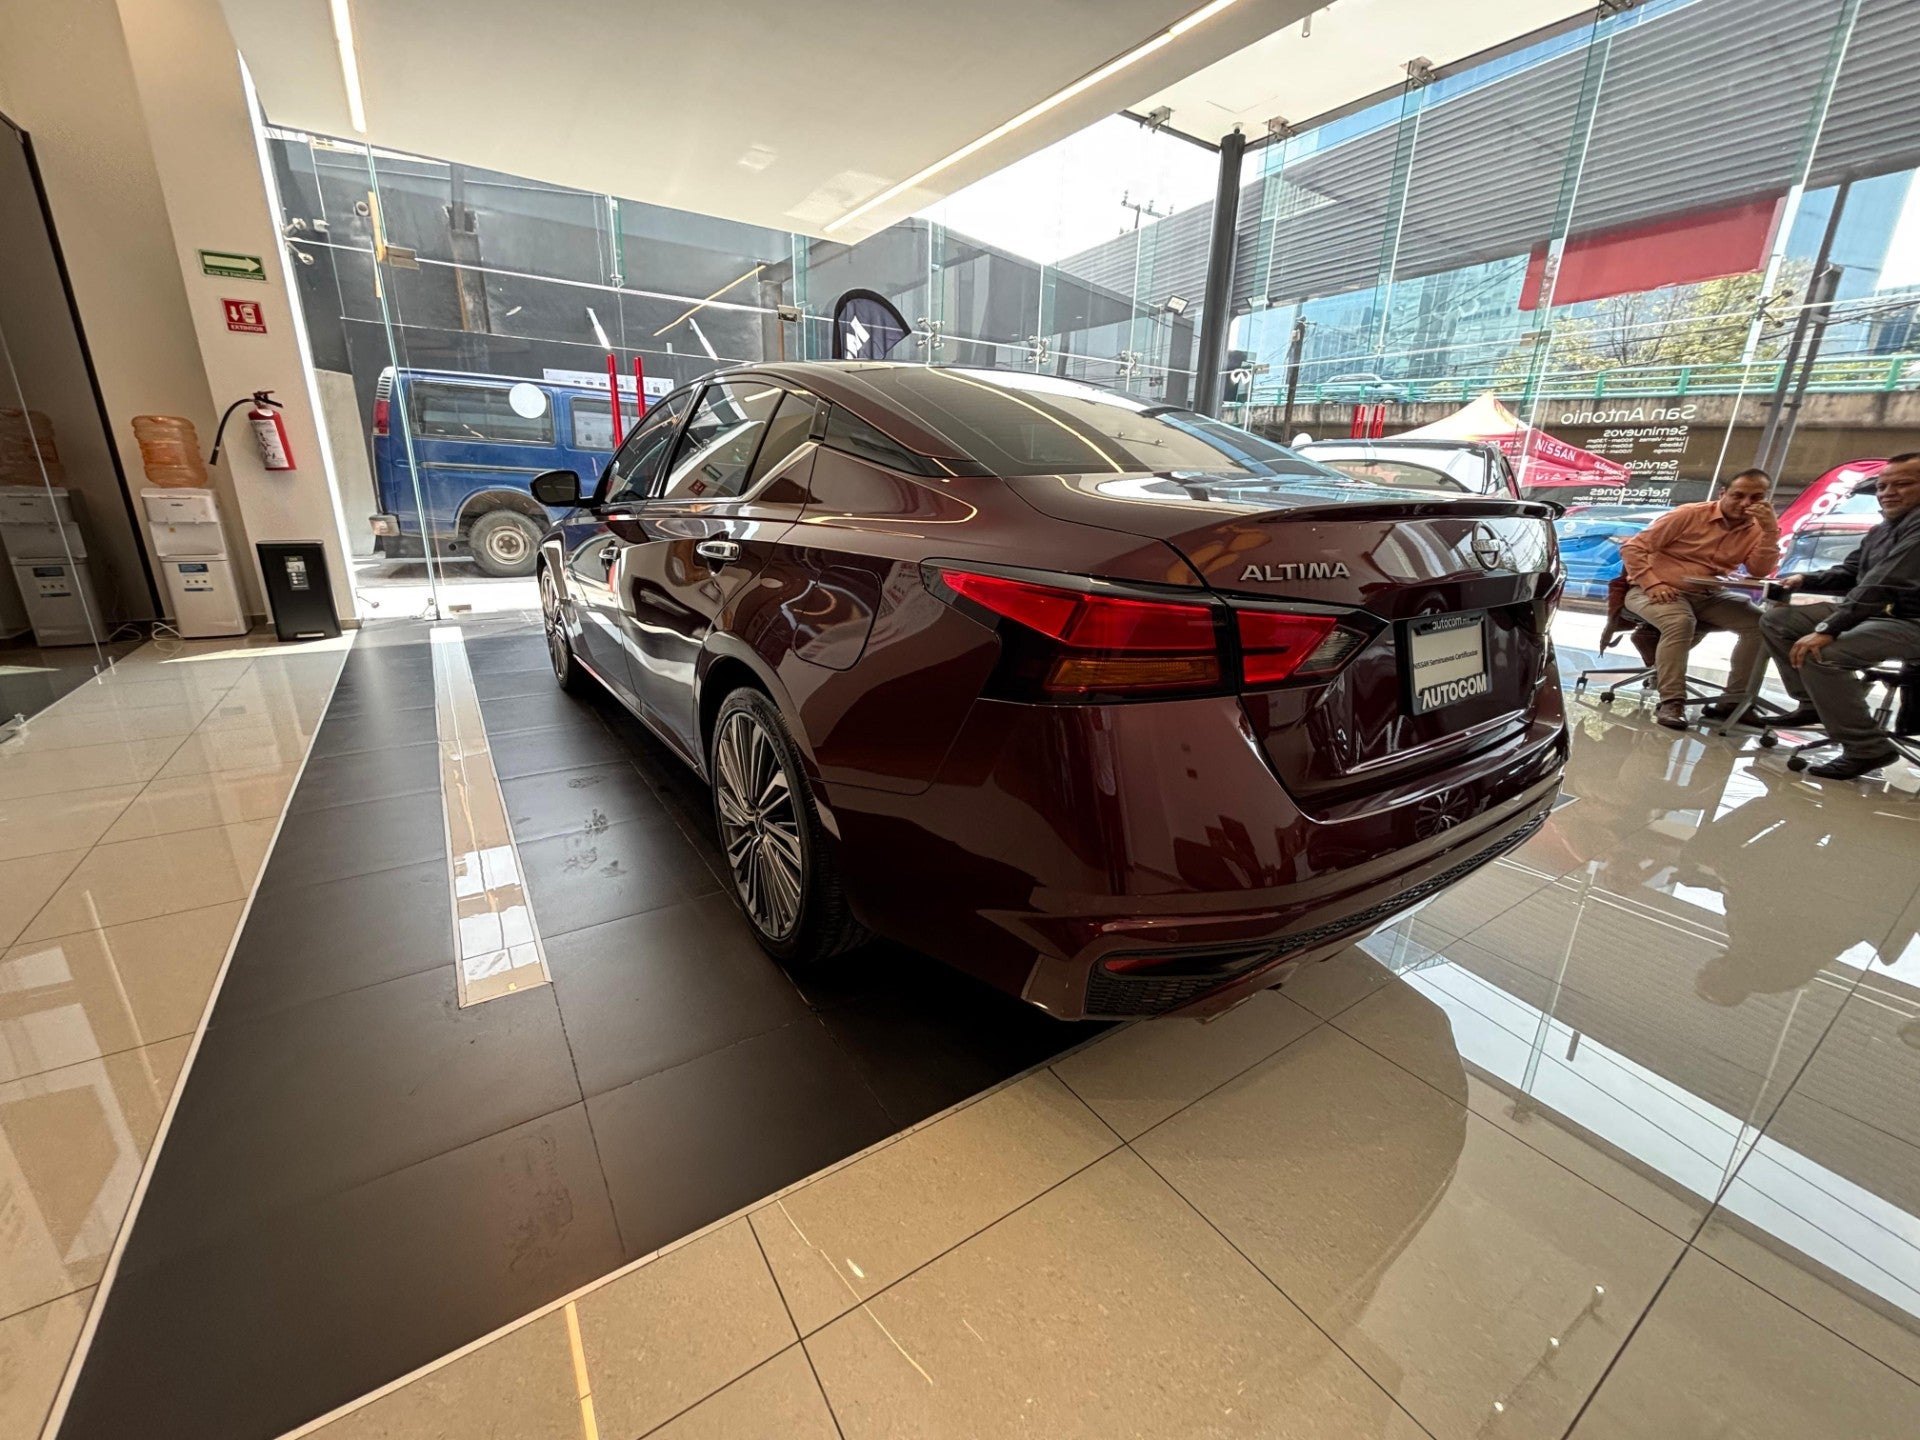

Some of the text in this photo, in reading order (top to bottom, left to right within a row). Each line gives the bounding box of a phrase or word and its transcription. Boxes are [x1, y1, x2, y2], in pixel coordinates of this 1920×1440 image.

[231, 324, 264, 332] EXTINTOR
[1535, 439, 1577, 461] NISSAN
[1240, 562, 1351, 581] ALTIMA
[1422, 673, 1487, 710] AUTOCOM
